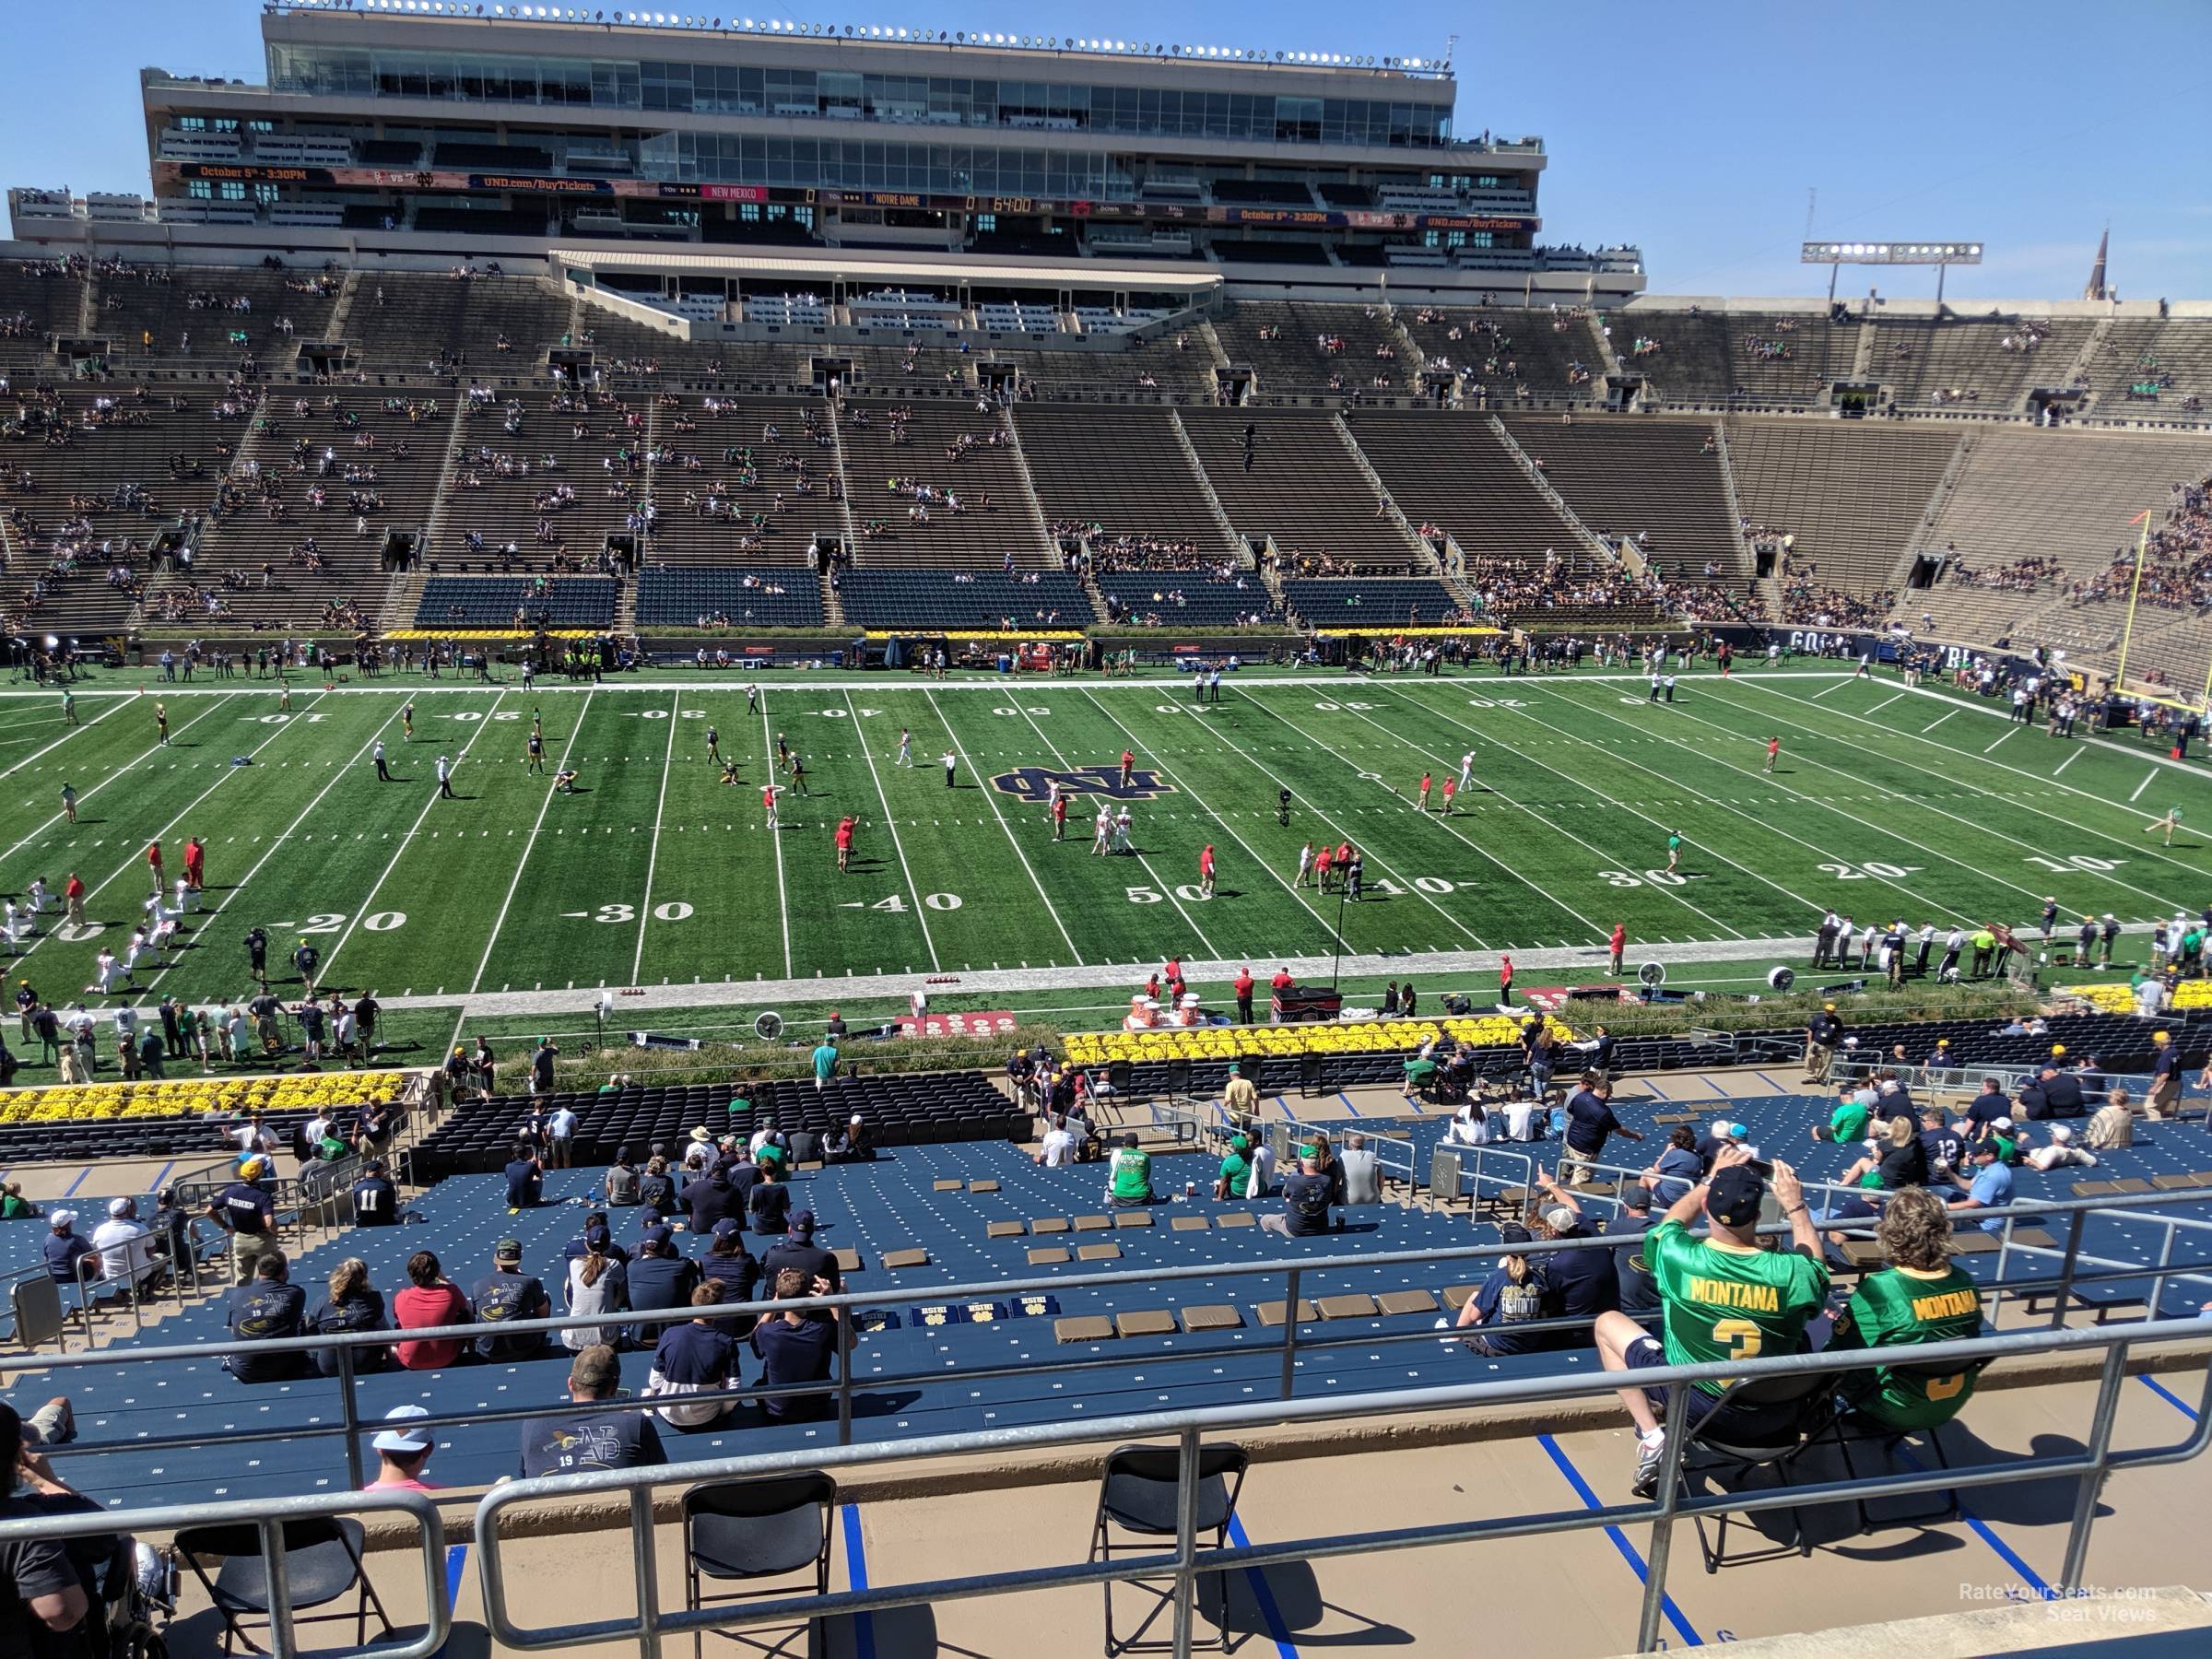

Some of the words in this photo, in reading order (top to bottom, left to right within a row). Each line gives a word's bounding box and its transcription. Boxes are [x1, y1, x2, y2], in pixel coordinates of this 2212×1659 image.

[201, 167, 241, 179] October
[267, 170, 307, 181] 3:30PM
[484, 177, 596, 192] UND.com/BuyTickets
[712, 187, 728, 197] NEW
[730, 188, 756, 199] MEXICO
[806, 189, 815, 203] 0
[877, 194, 899, 206] NOTRE
[900, 194, 920, 206] DAME
[967, 196, 974, 209] 0
[994, 198, 1031, 213] 64:00
[1241, 208, 1274, 220] October
[1294, 212, 1327, 223] 3:30PM
[1428, 218, 1522, 229] UND.com/BuyTickets
[261, 713, 333, 724] 10
[454, 712, 524, 721] 20
[642, 710, 708, 719] 30
[822, 709, 885, 719] 40
[993, 707, 1051, 717] 50
[2024, 854, 2113, 872] 10
[1817, 862, 1909, 879] 20
[1597, 869, 1686, 887] 30
[1126, 885, 1213, 904] 50
[871, 893, 963, 913] 40
[594, 901, 694, 923] 30
[297, 911, 407, 934] 20
[532, 1120, 538, 1134] 5
[1937, 1139, 1958, 1161] 12
[229, 1197, 256, 1210] USHER
[360, 1189, 378, 1211] 11
[1689, 1277, 1779, 1312] MONTANA
[1912, 1288, 1979, 1322] MONTANA
[559, 1454, 573, 1466] 19
